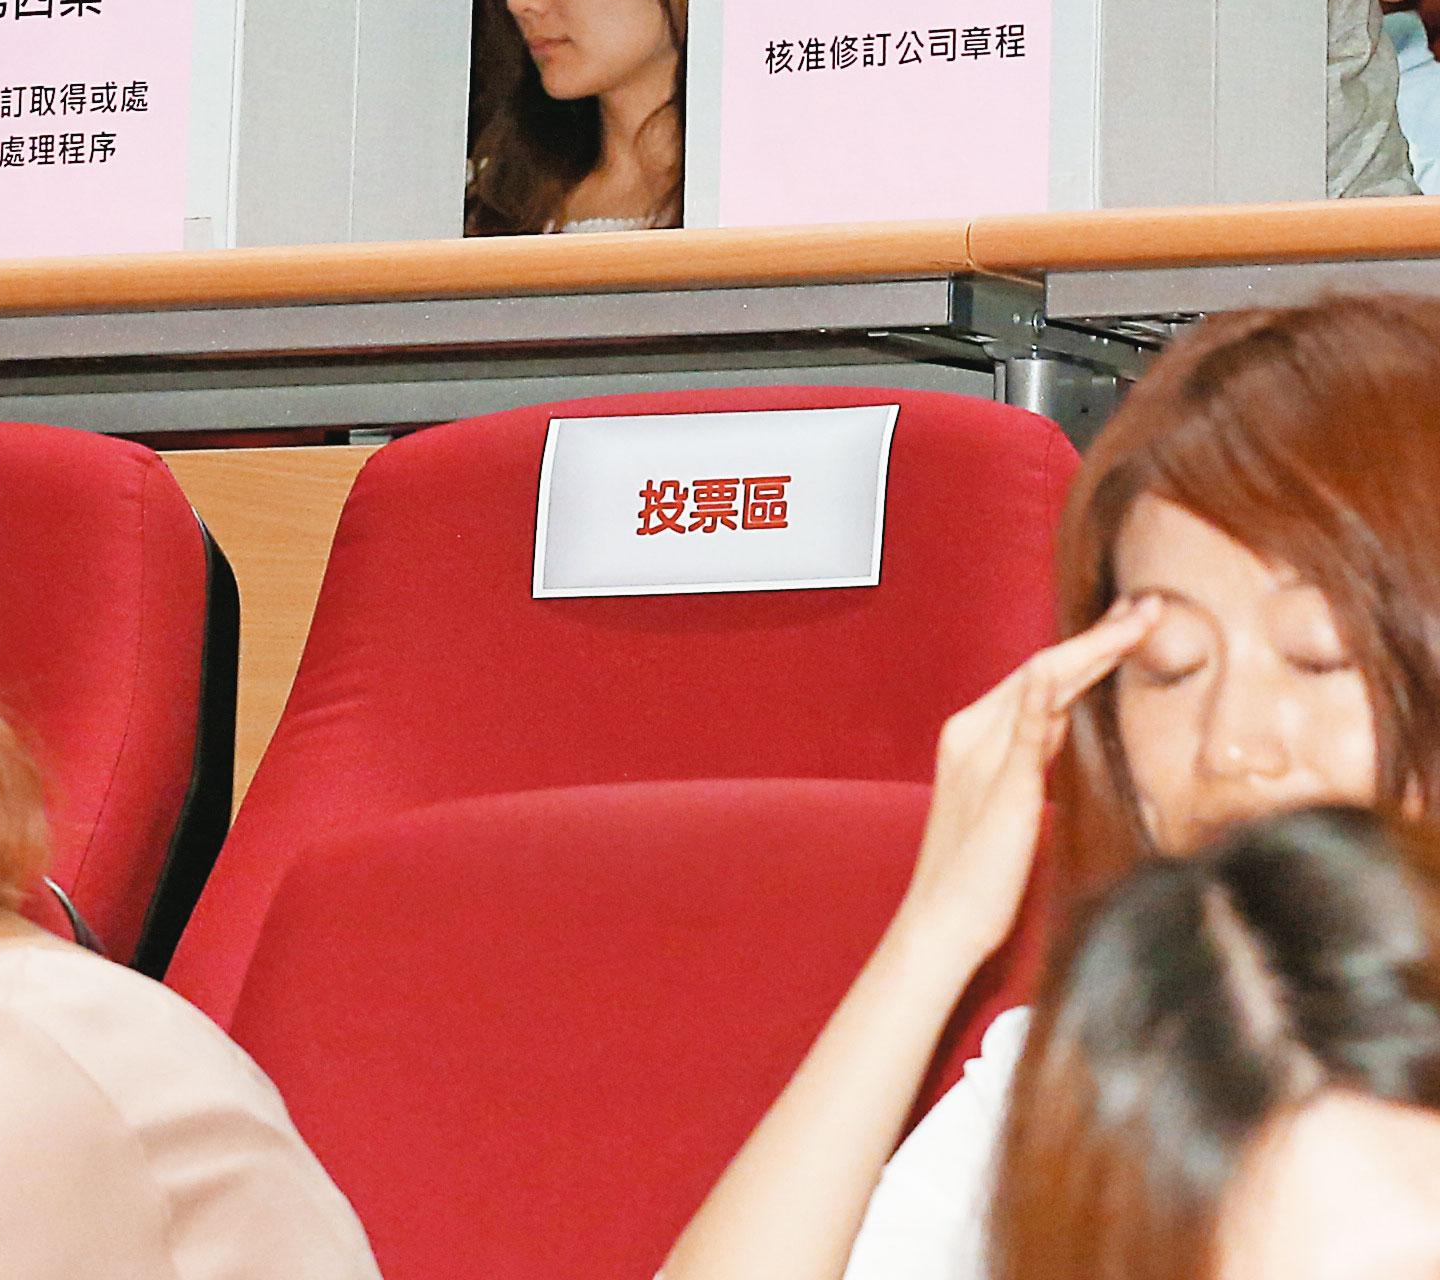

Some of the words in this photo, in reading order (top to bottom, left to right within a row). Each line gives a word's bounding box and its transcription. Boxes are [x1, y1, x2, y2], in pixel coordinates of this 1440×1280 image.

[764, 23, 1027, 76] 核准修訂公司章程
[635, 475, 793, 537] 投票區
